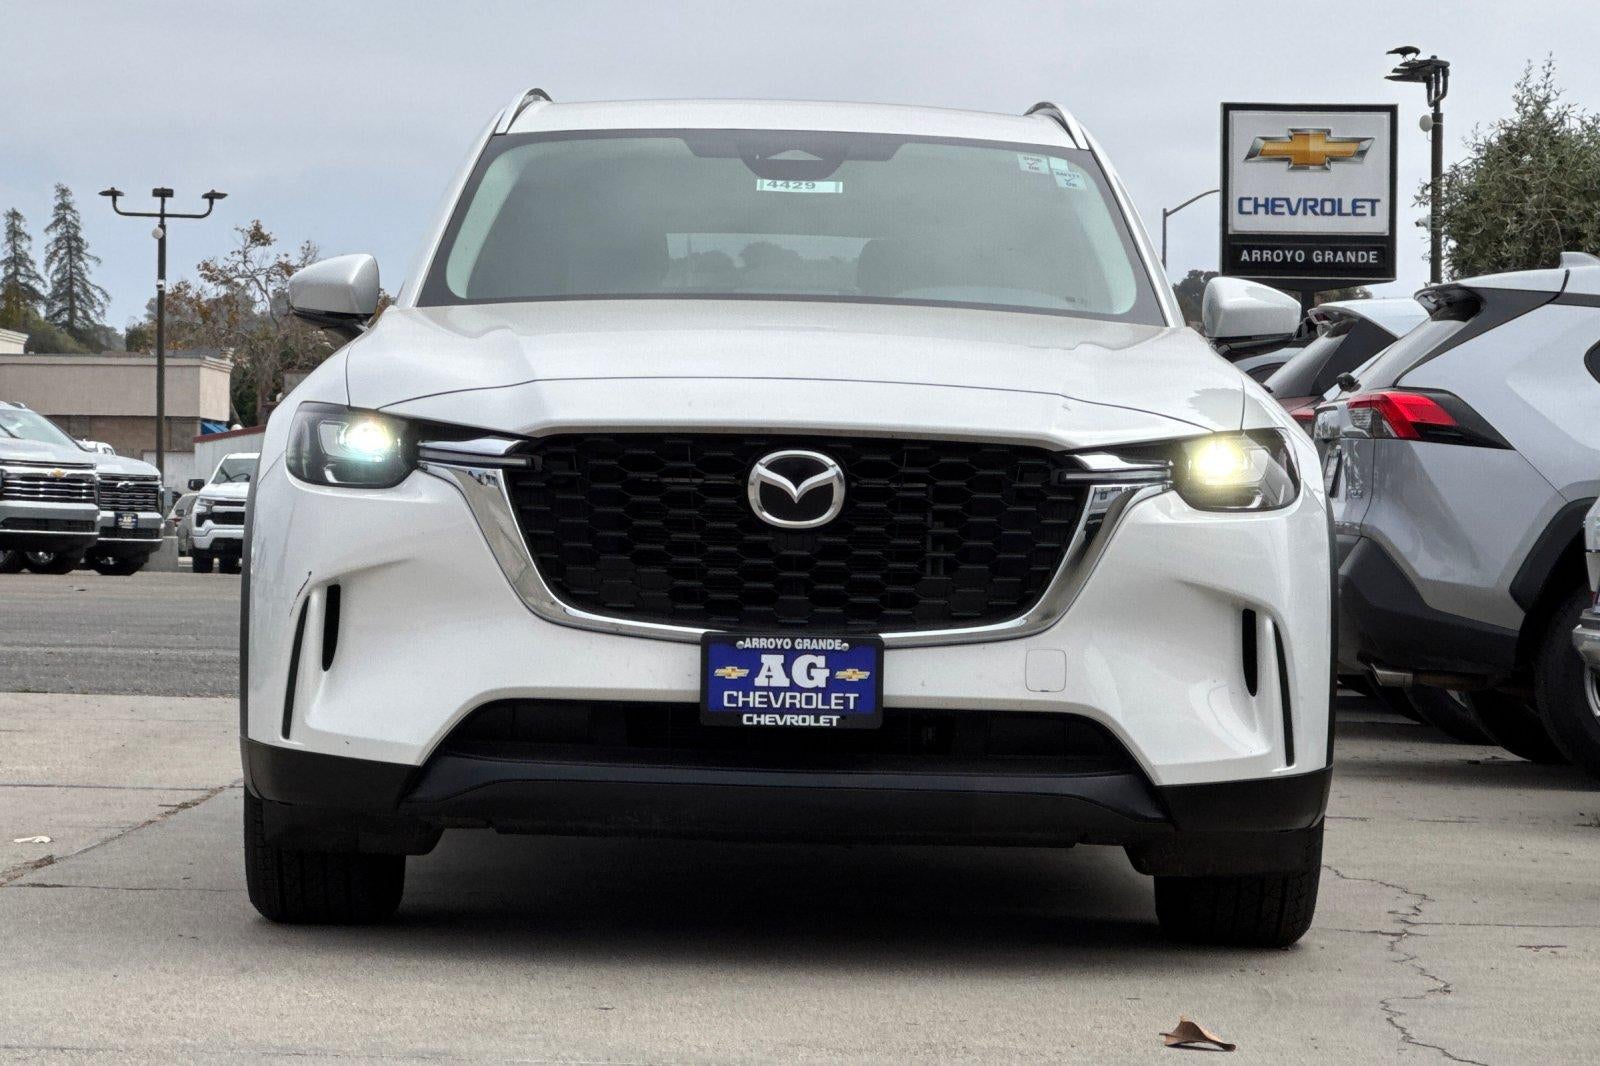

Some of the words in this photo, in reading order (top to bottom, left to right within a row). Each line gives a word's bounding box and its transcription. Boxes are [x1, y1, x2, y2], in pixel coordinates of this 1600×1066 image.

[766, 181, 816, 190] 4429
[1238, 197, 1381, 217] CHEVROLET
[1241, 250, 1305, 263] ARROYO
[1313, 251, 1378, 263] GRANDE
[743, 638, 791, 649] ARROYO
[795, 639, 842, 650] GRANDE
[754, 654, 830, 688] AG
[723, 691, 859, 710] CHEVROLET
[742, 713, 840, 727] CHEVROLET
